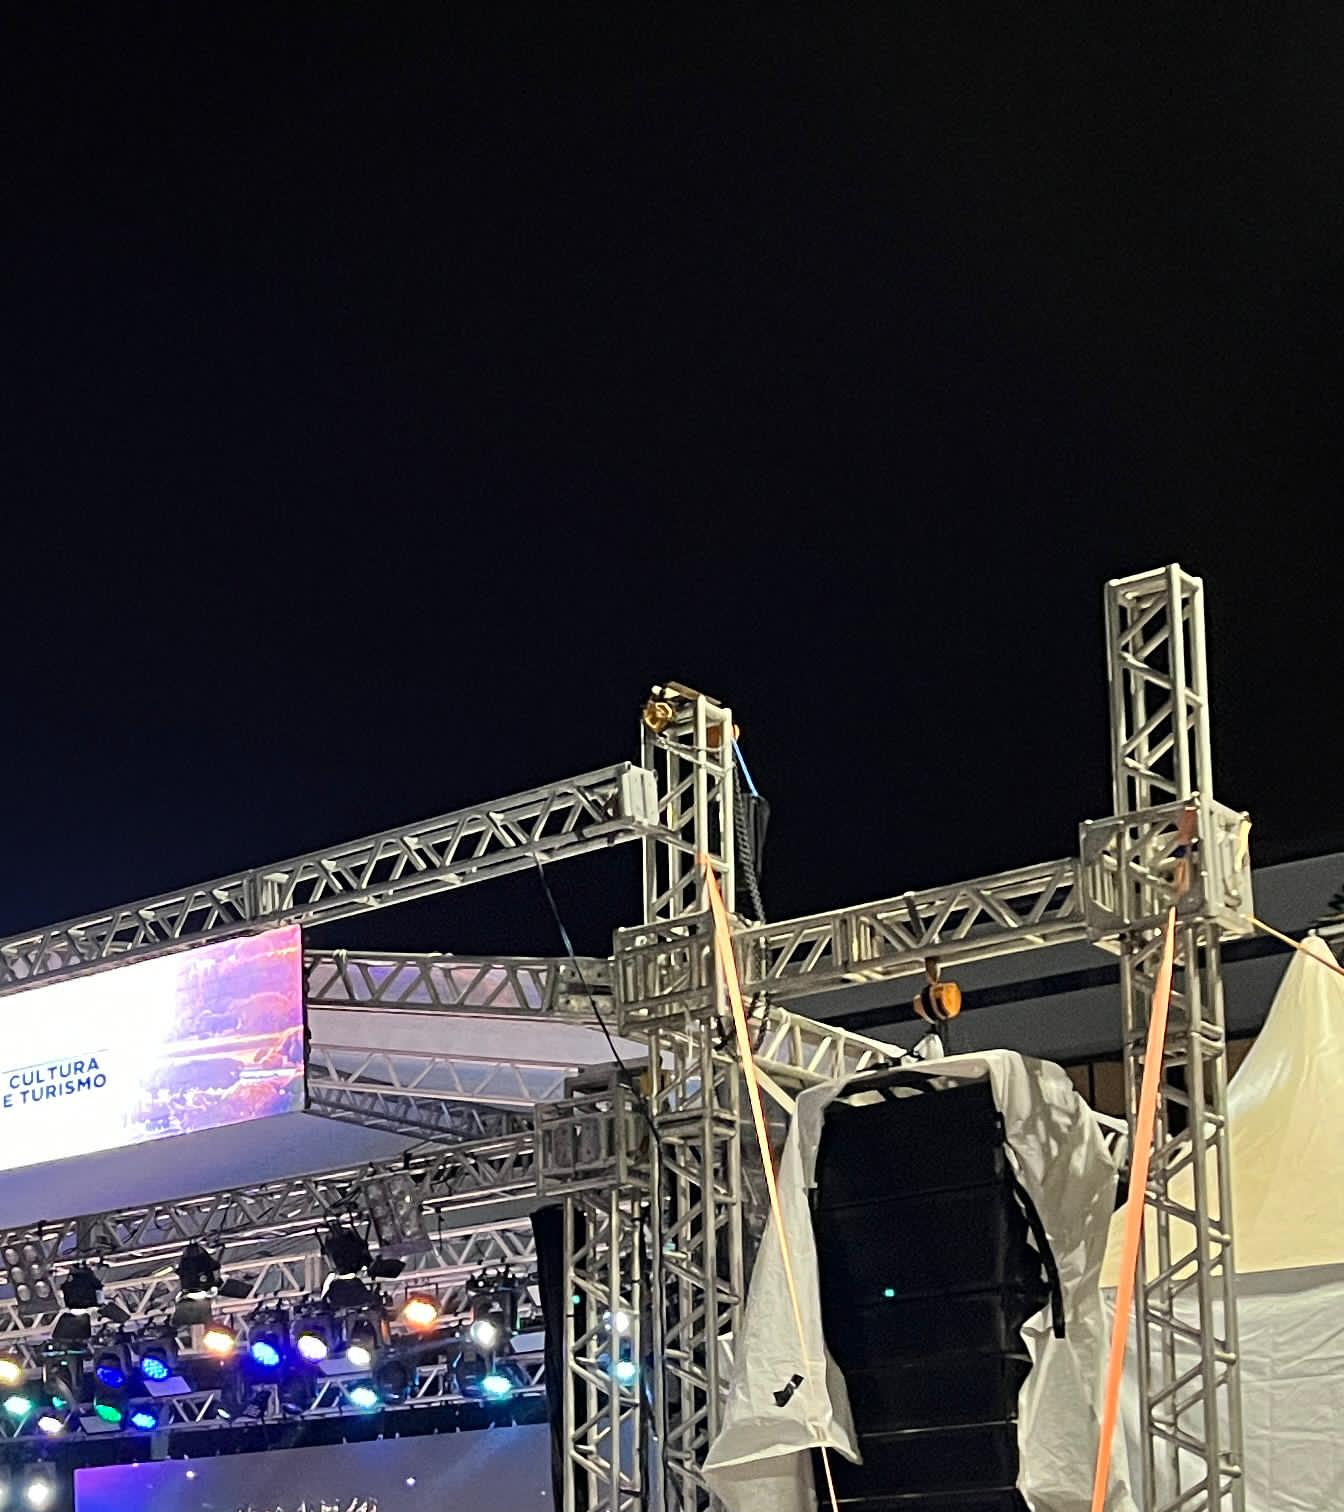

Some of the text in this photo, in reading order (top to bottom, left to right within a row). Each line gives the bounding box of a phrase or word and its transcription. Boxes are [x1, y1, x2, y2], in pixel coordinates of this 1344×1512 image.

[9, 1058, 99, 1089] CULTURA
[3, 1073, 107, 1108] E TURISMO
